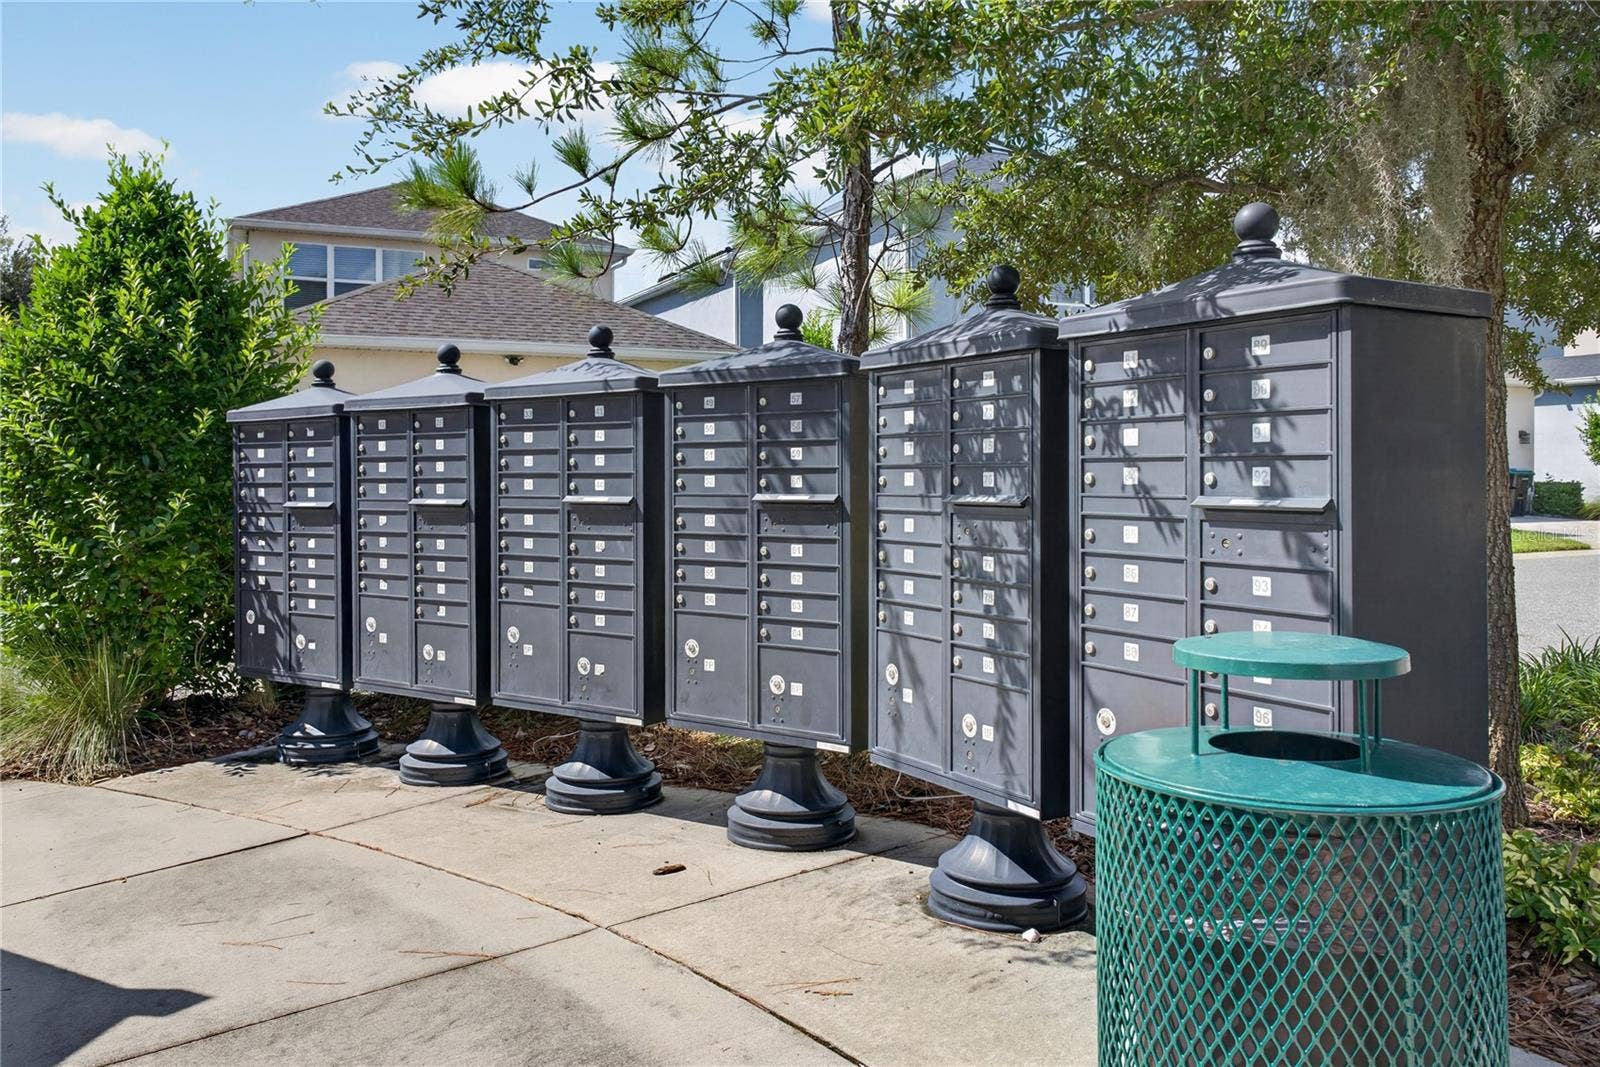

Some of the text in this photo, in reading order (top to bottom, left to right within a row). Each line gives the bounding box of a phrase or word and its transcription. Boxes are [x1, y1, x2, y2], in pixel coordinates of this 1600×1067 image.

[1254, 469, 1268, 482] 92
[1254, 578, 1269, 592] 93
[1125, 606, 1137, 619] 87
[1255, 709, 1270, 724] 96
